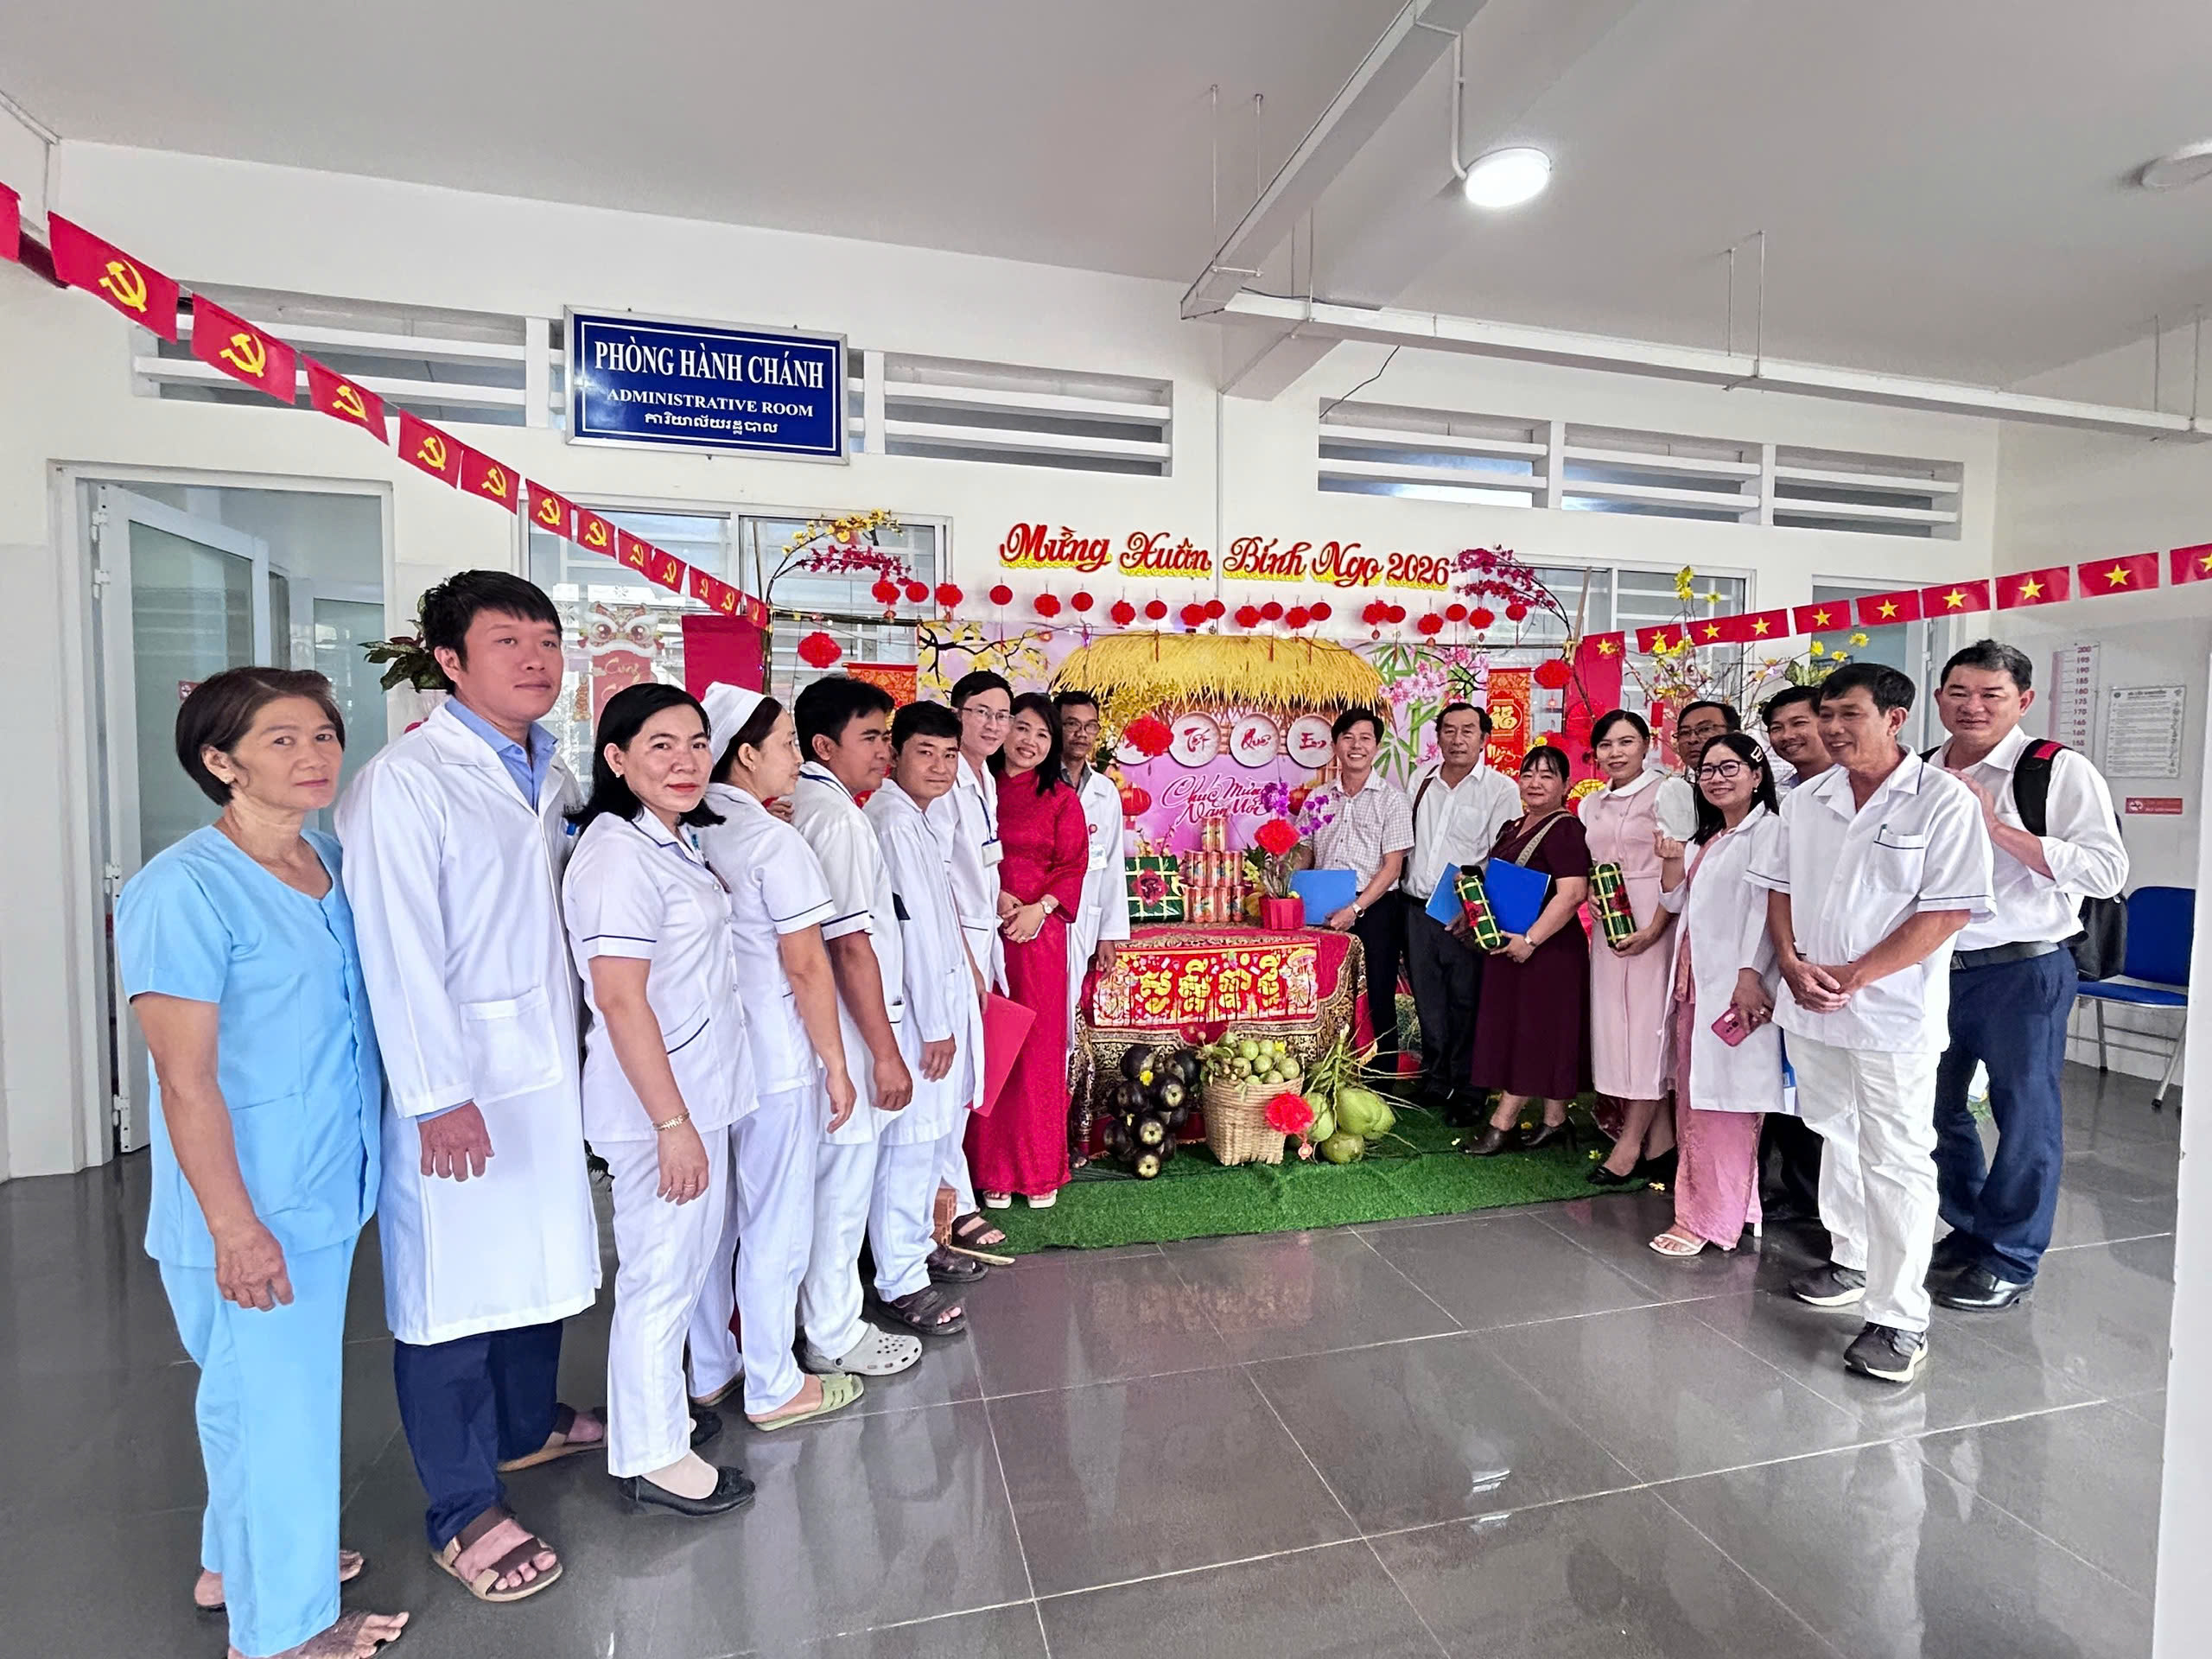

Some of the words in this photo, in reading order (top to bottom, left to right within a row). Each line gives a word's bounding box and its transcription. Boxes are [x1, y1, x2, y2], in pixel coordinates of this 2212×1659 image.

[594, 335, 675, 376] PHÒNG
[679, 342, 743, 382] HÀNH
[747, 350, 824, 389] CHÁNH
[607, 388, 758, 413] ADMINISTRATIVE
[761, 401, 814, 417] ROOM
[1000, 522, 1112, 573] Mừng
[1120, 531, 1212, 576] Xuân
[1223, 536, 1312, 580] Bính
[1311, 540, 1383, 588] Ngọ
[1386, 553, 1450, 586] 2026
[1490, 705, 1518, 730] 福
